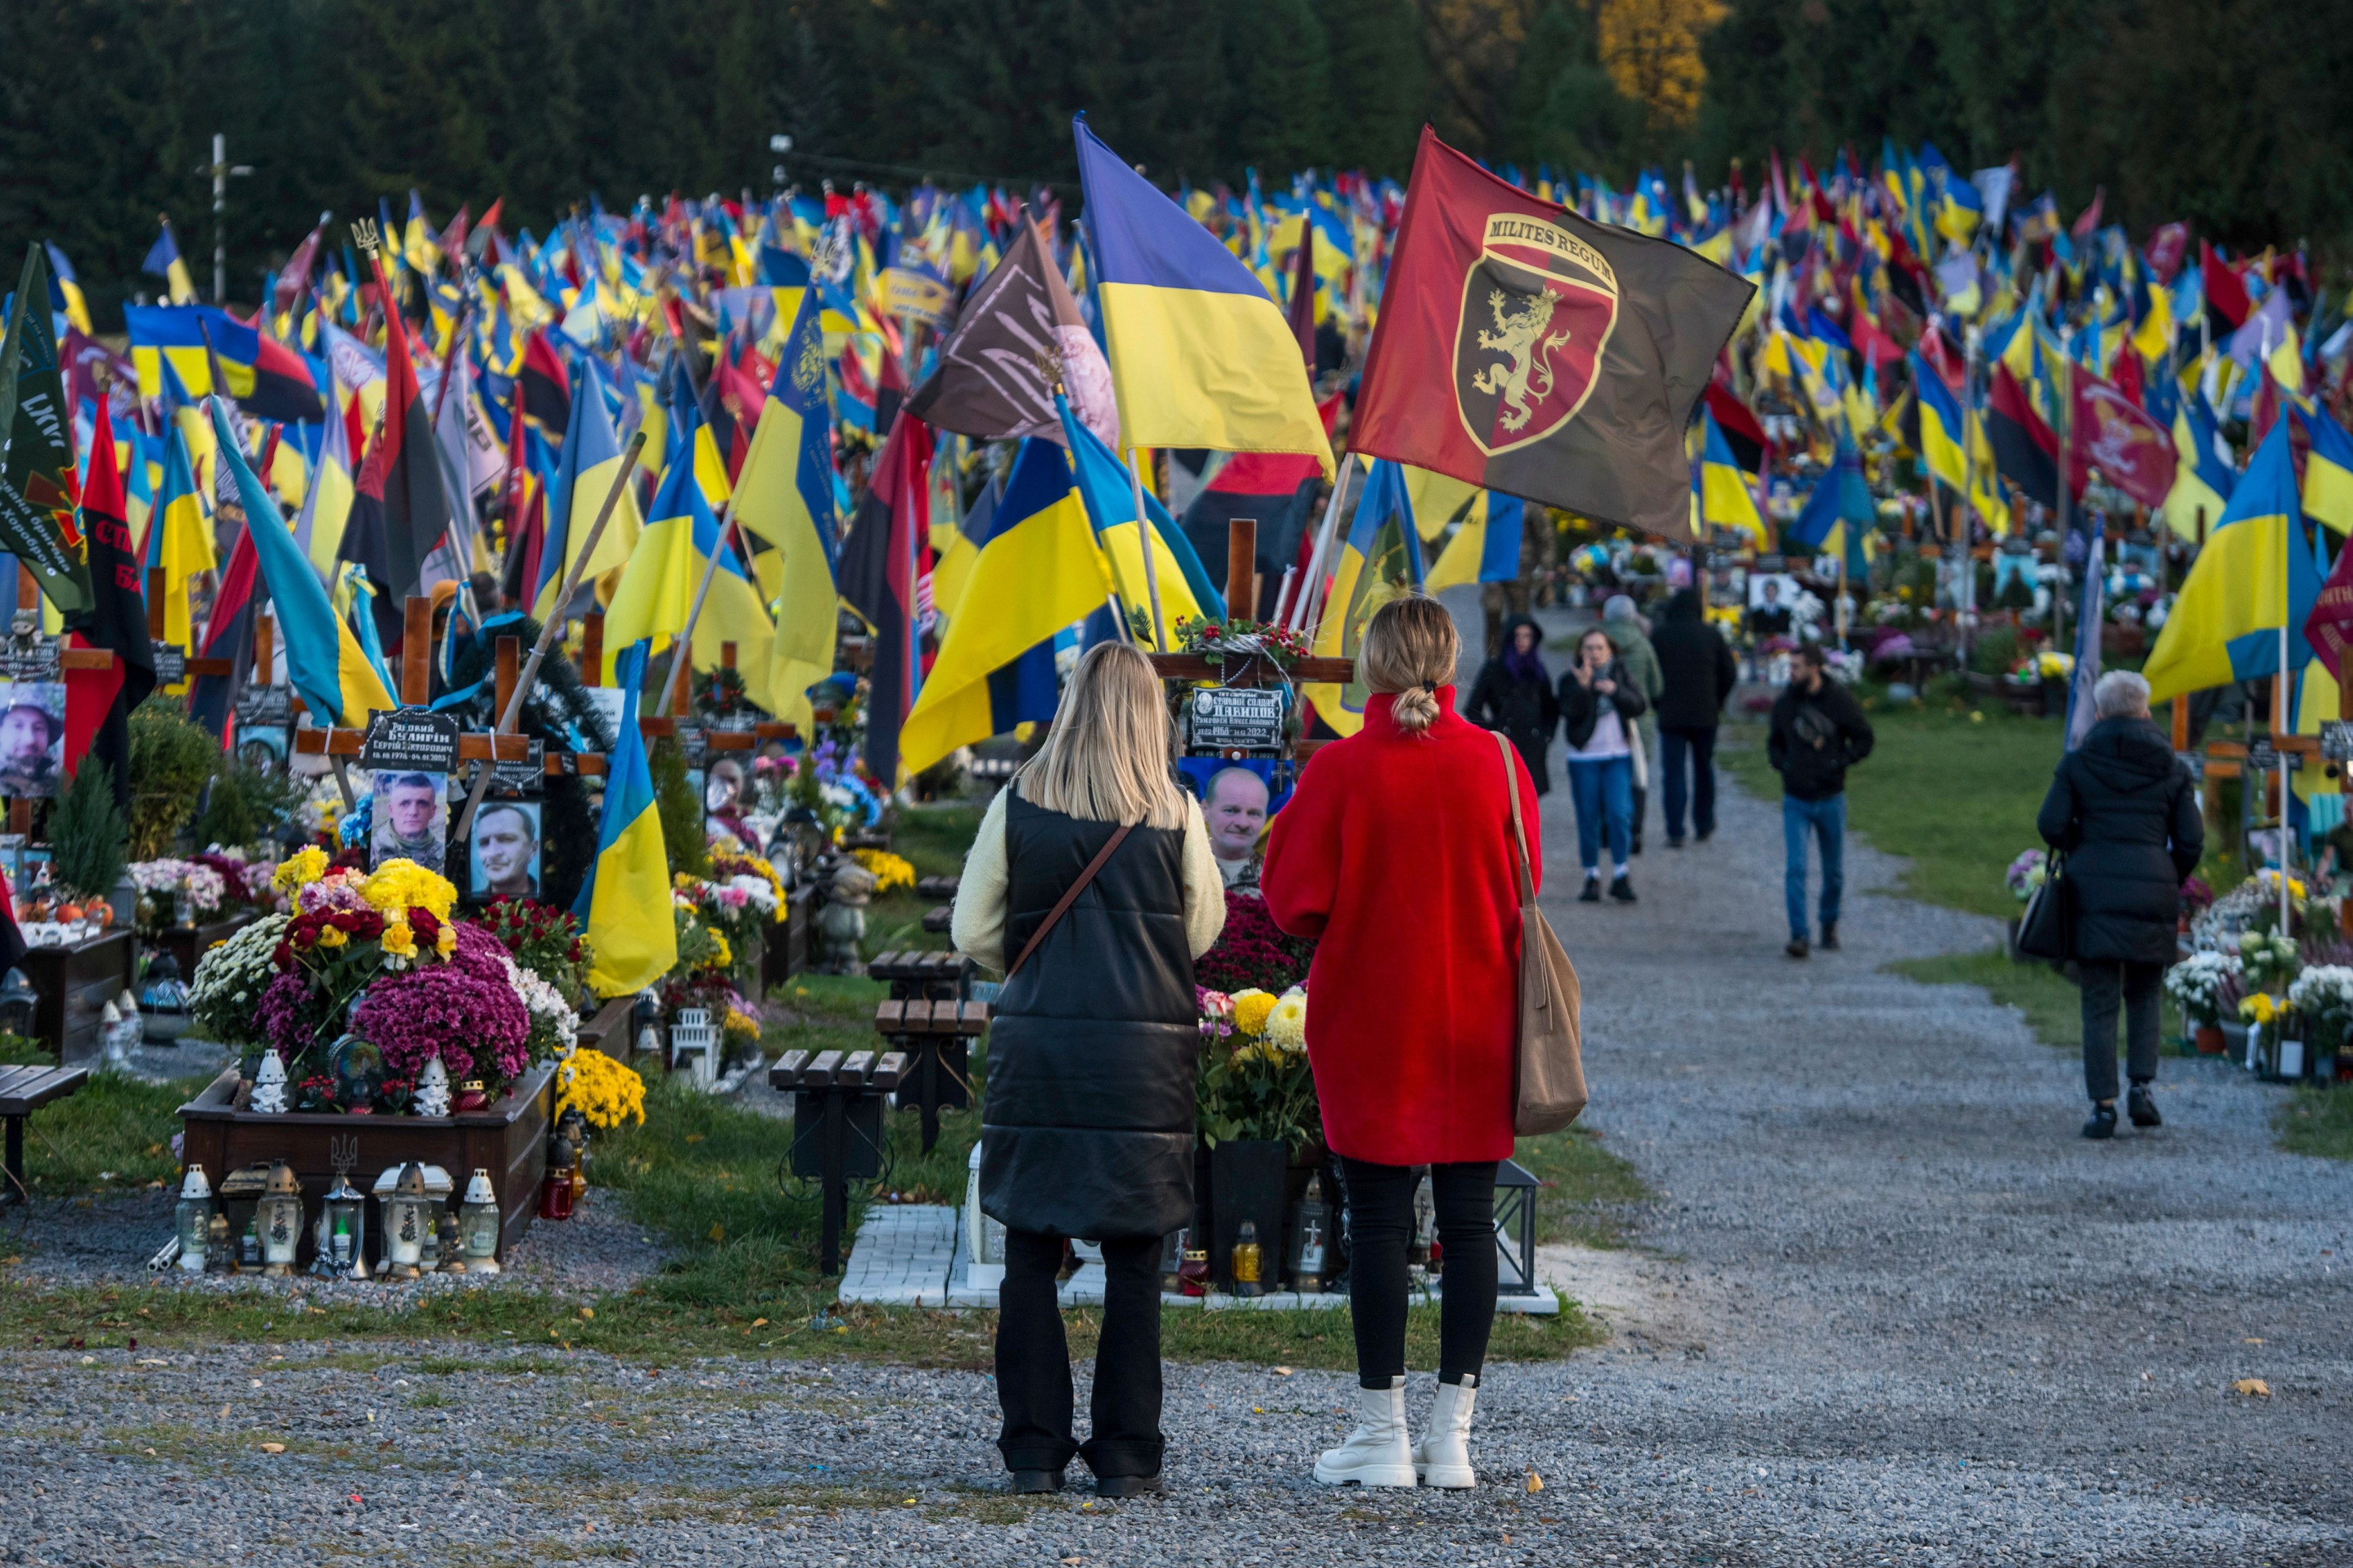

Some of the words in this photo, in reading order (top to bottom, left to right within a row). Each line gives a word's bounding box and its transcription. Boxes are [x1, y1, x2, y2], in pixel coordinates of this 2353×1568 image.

[1489, 221, 1554, 246] MILITES
[1557, 233, 1612, 282] REGUM
[1, 509, 56, 576] Хороброго
[31, 516, 70, 572] бригада
[388, 729, 450, 743] БУЛИГІН
[1213, 704, 1275, 718] ДАВИДОВ
